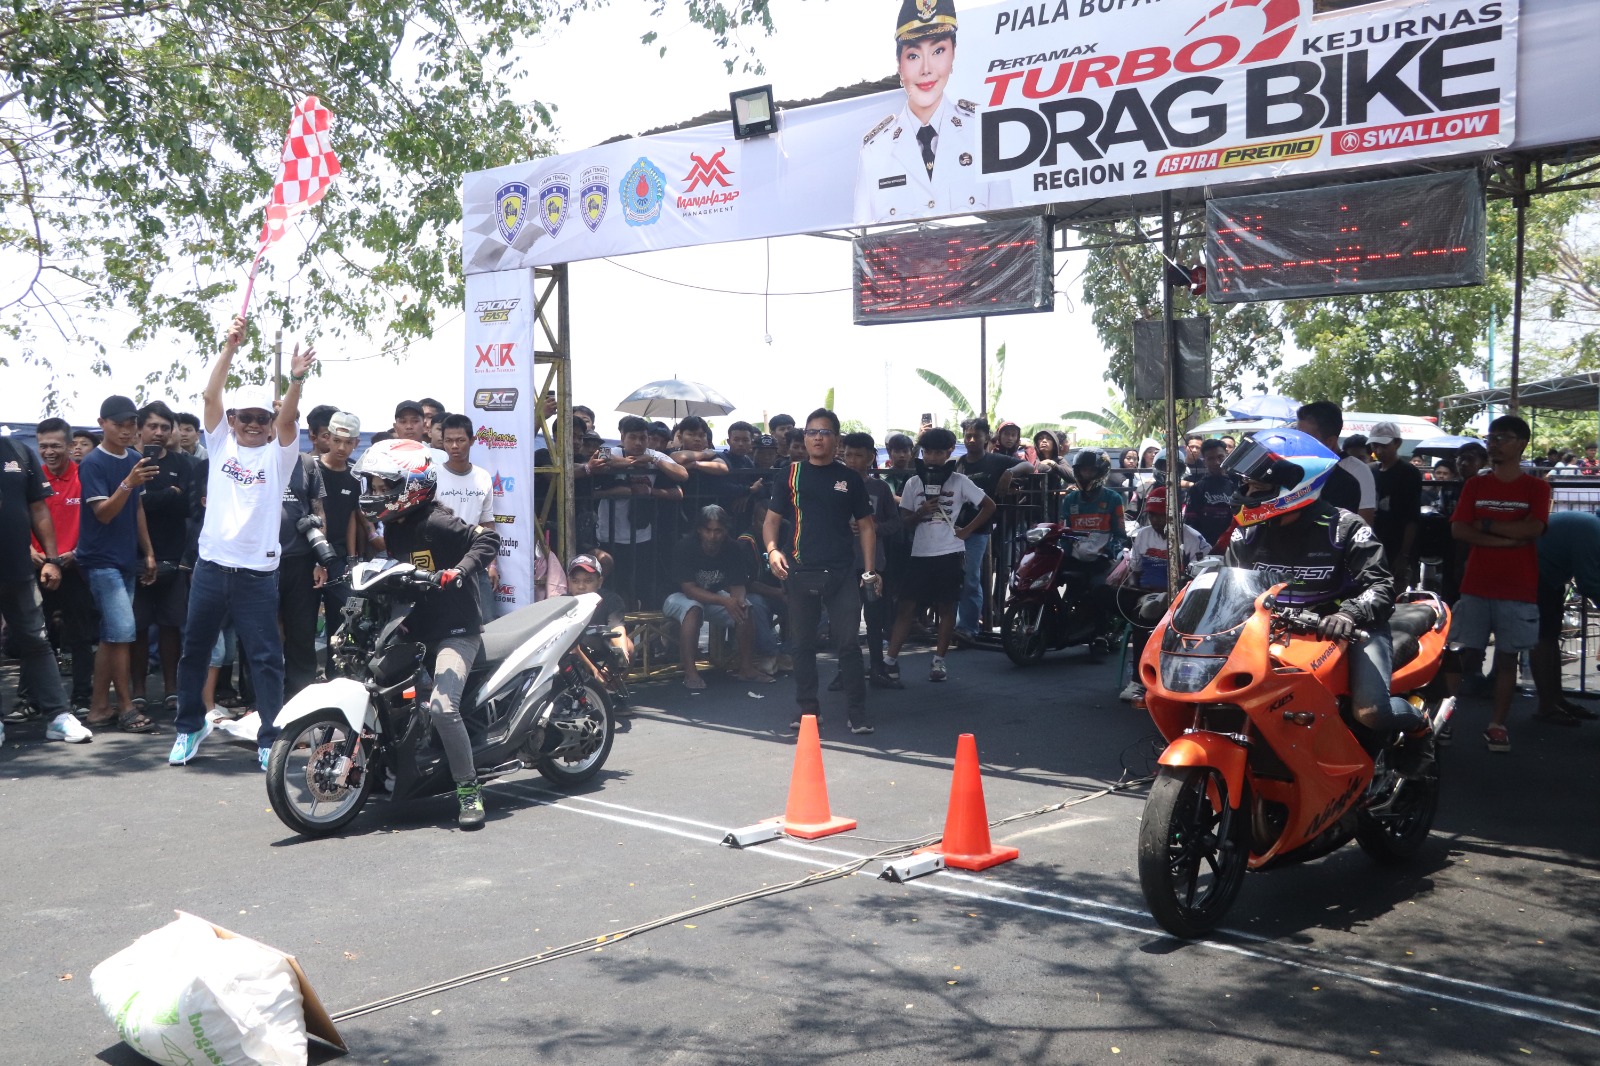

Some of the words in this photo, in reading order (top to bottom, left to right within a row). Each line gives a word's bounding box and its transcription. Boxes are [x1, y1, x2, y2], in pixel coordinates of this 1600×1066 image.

[994, 1, 1070, 35] PIALA
[1302, 2, 1503, 55] KEJURNAS
[984, 35, 1241, 107] TURBO
[987, 42, 1099, 73] PERTAMAX
[981, 75, 1228, 175] DRAG
[1245, 24, 1503, 140] BIKE
[1362, 115, 1489, 148] SWALLOW
[1159, 152, 1218, 173] ASPIRA
[1223, 139, 1316, 163] PREMIO
[1033, 161, 1125, 192] REGION
[1133, 159, 1148, 180] 2
[682, 205, 734, 218] MANAGEMENT
[475, 299, 521, 312] RACING
[482, 310, 510, 320] FAST
[1310, 643, 1337, 671] Kawasa
[187, 1011, 227, 1066] bogas
